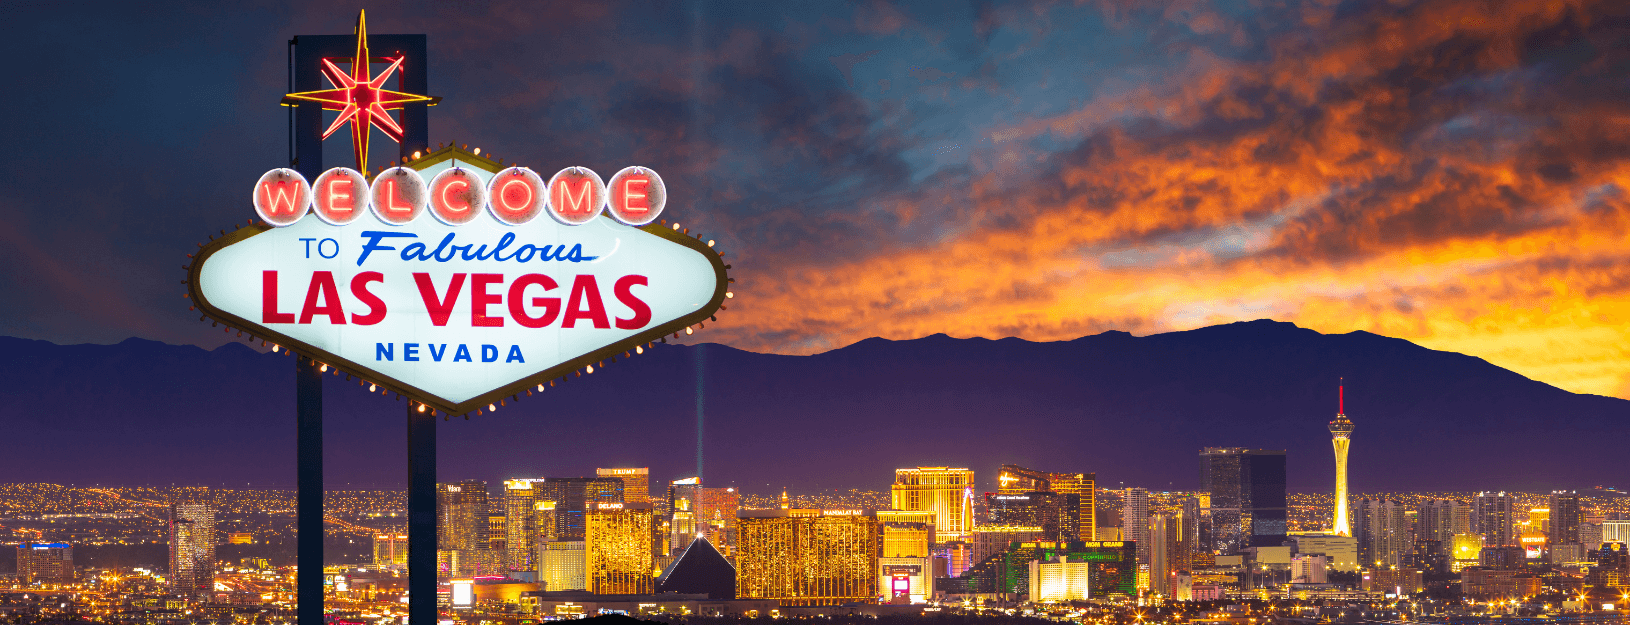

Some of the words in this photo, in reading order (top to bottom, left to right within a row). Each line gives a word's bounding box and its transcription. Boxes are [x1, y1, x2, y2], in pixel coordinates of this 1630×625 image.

[258, 176, 653, 216] WELCOME
[299, 238, 339, 259] TO
[357, 231, 599, 267] Fabulous
[263, 271, 387, 325] LAS
[412, 273, 651, 329] VEGAS
[376, 343, 525, 363] NEVADA
